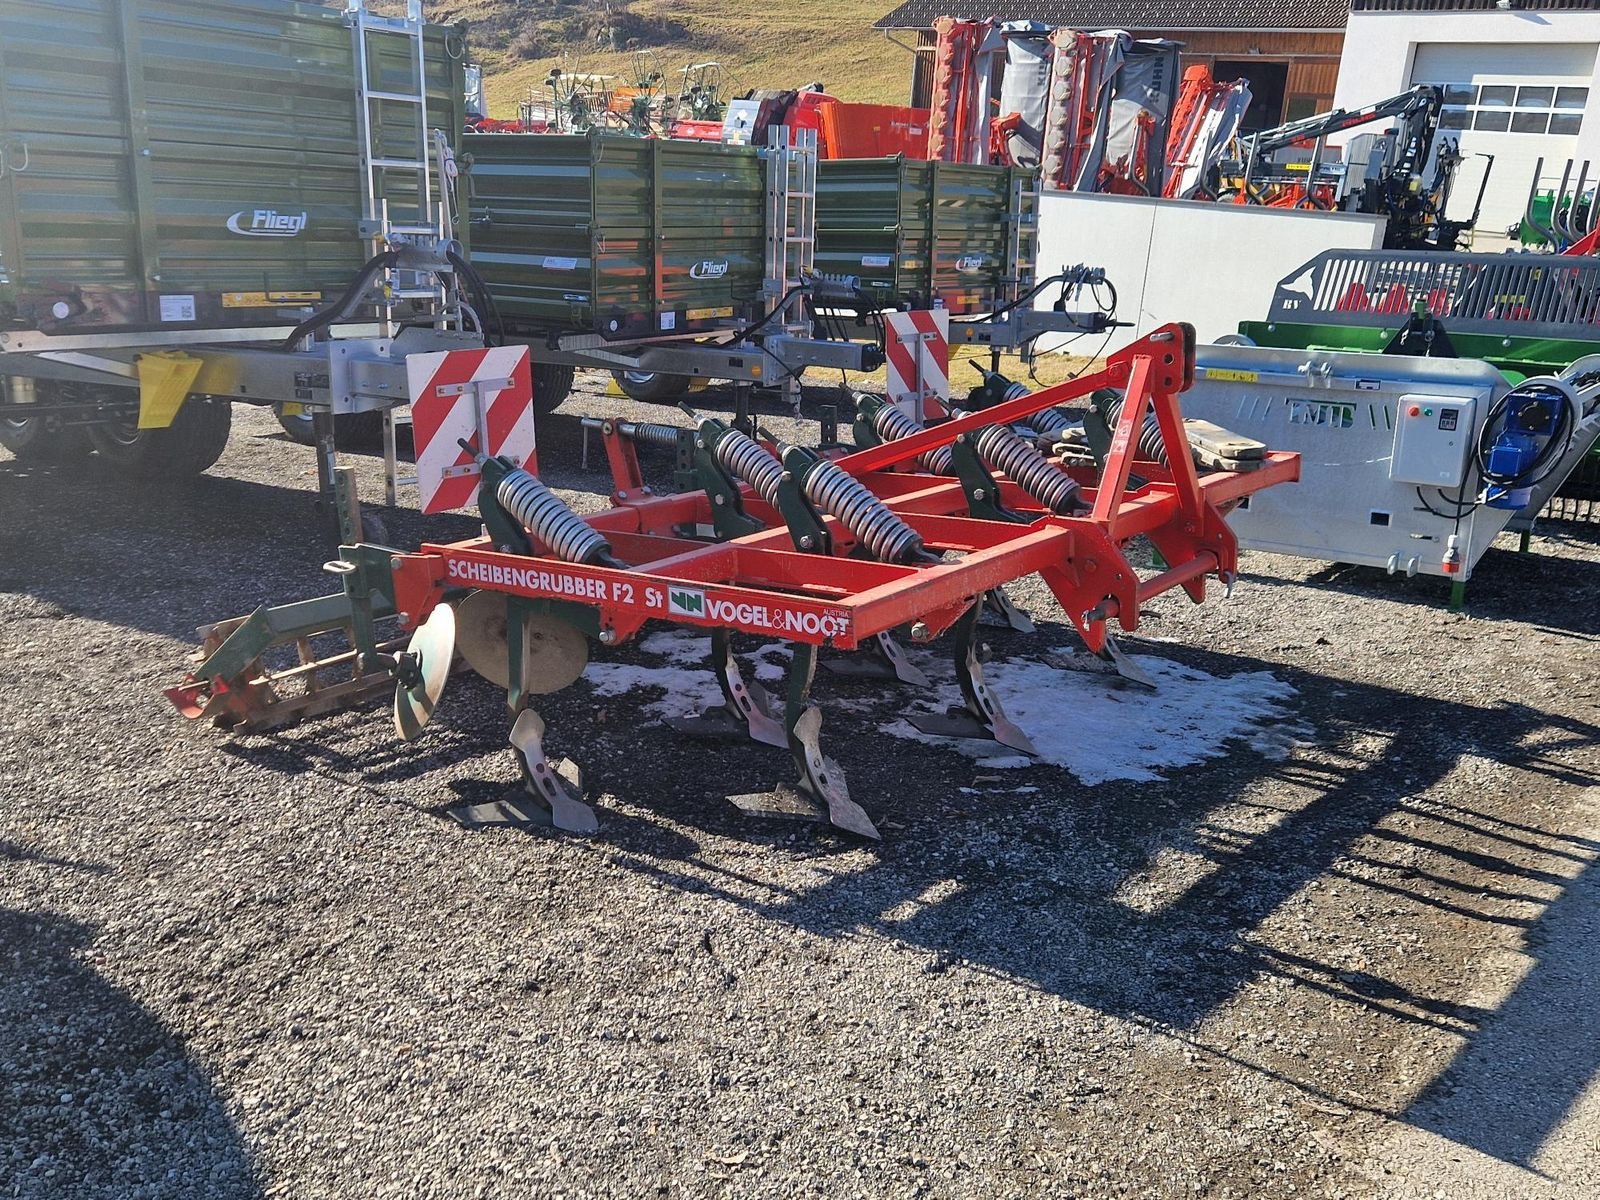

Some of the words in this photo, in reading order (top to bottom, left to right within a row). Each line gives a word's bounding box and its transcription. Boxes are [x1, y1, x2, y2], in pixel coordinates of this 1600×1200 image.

[251, 208, 307, 233] Fliegl
[701, 260, 729, 276] Fliegl
[448, 559, 607, 600] SCHEIBENGRUBBER
[612, 582, 635, 604] F2
[645, 587, 663, 609] St
[823, 608, 850, 618] AUSTRIA
